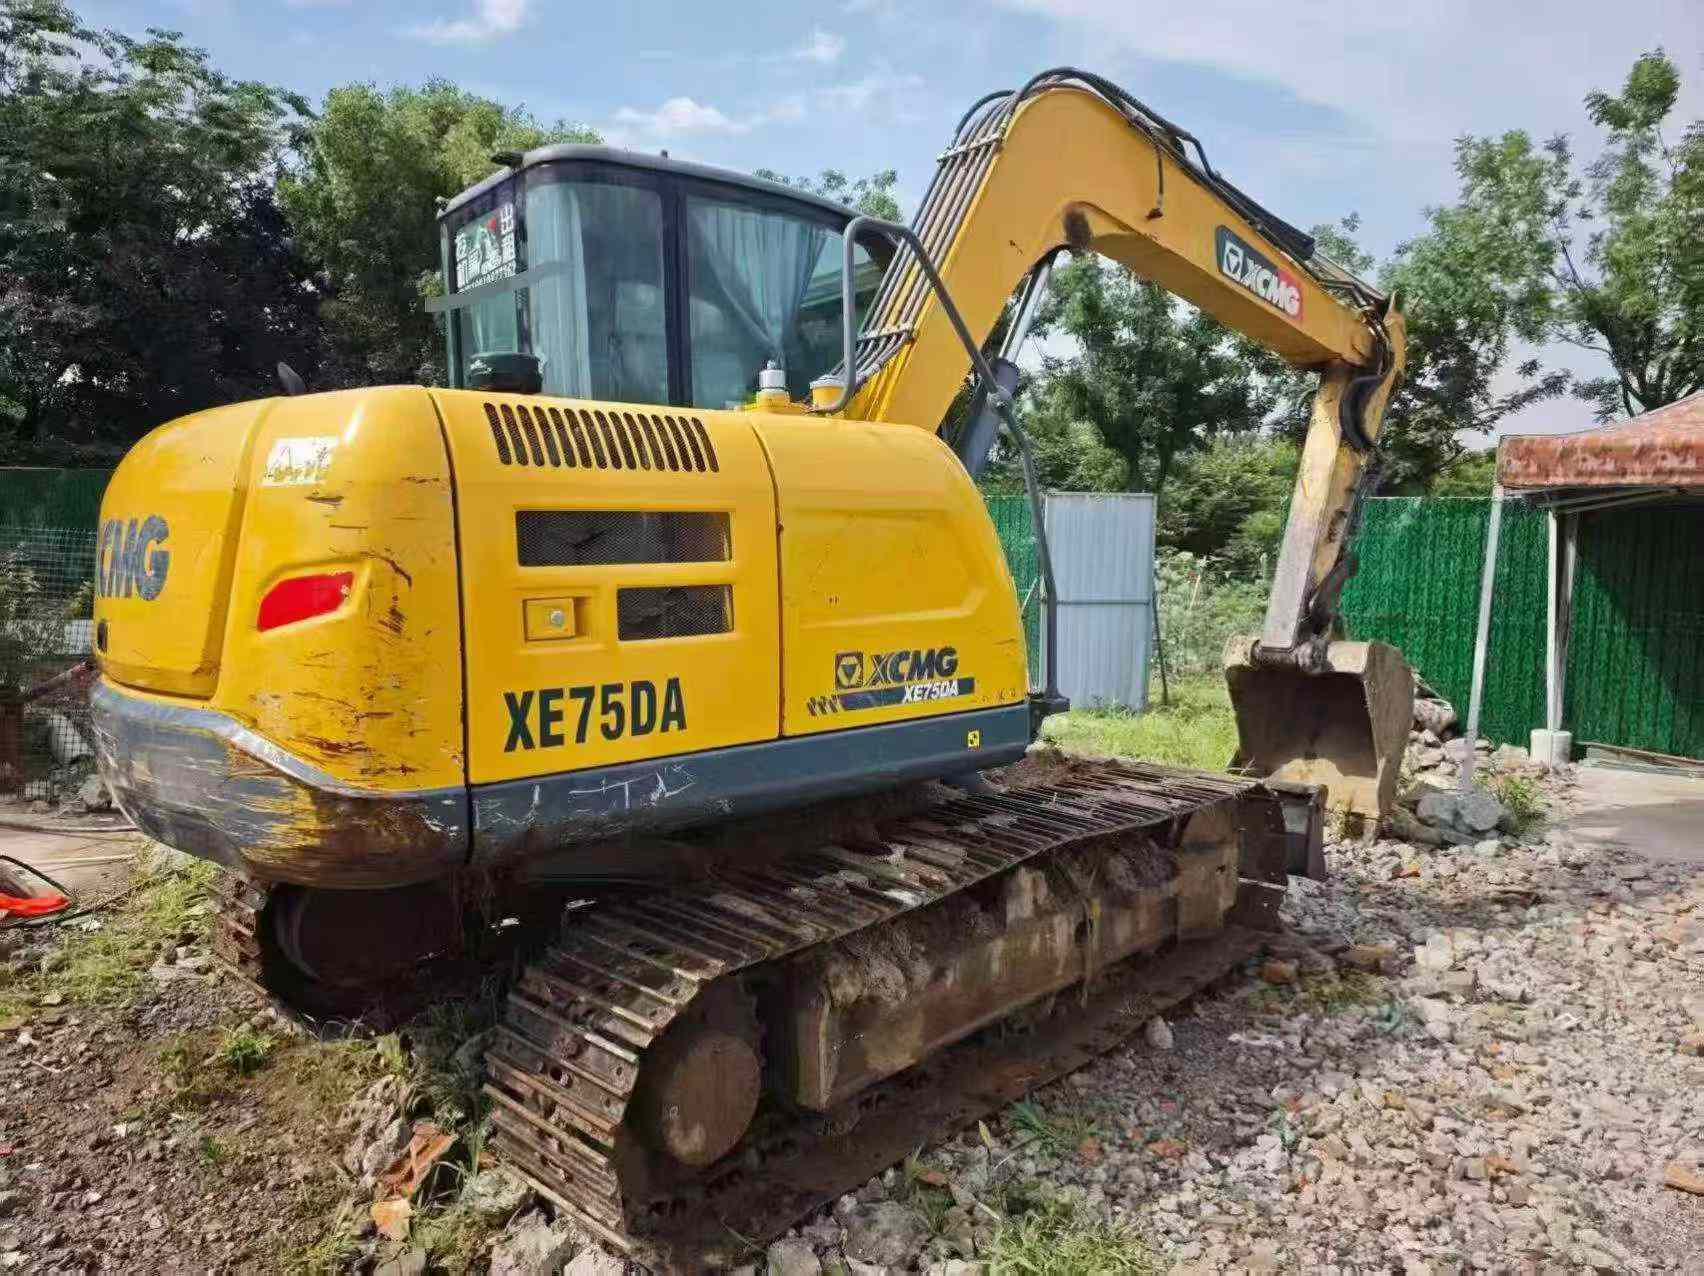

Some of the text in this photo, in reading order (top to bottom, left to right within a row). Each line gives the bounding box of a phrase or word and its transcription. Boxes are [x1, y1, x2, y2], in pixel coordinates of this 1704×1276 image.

[1240, 256, 1301, 317] XCMG
[98, 515, 169, 600] CMG
[867, 646, 958, 686] XCMG
[902, 680, 959, 703] XE75DA
[502, 677, 687, 753] XE75DA
